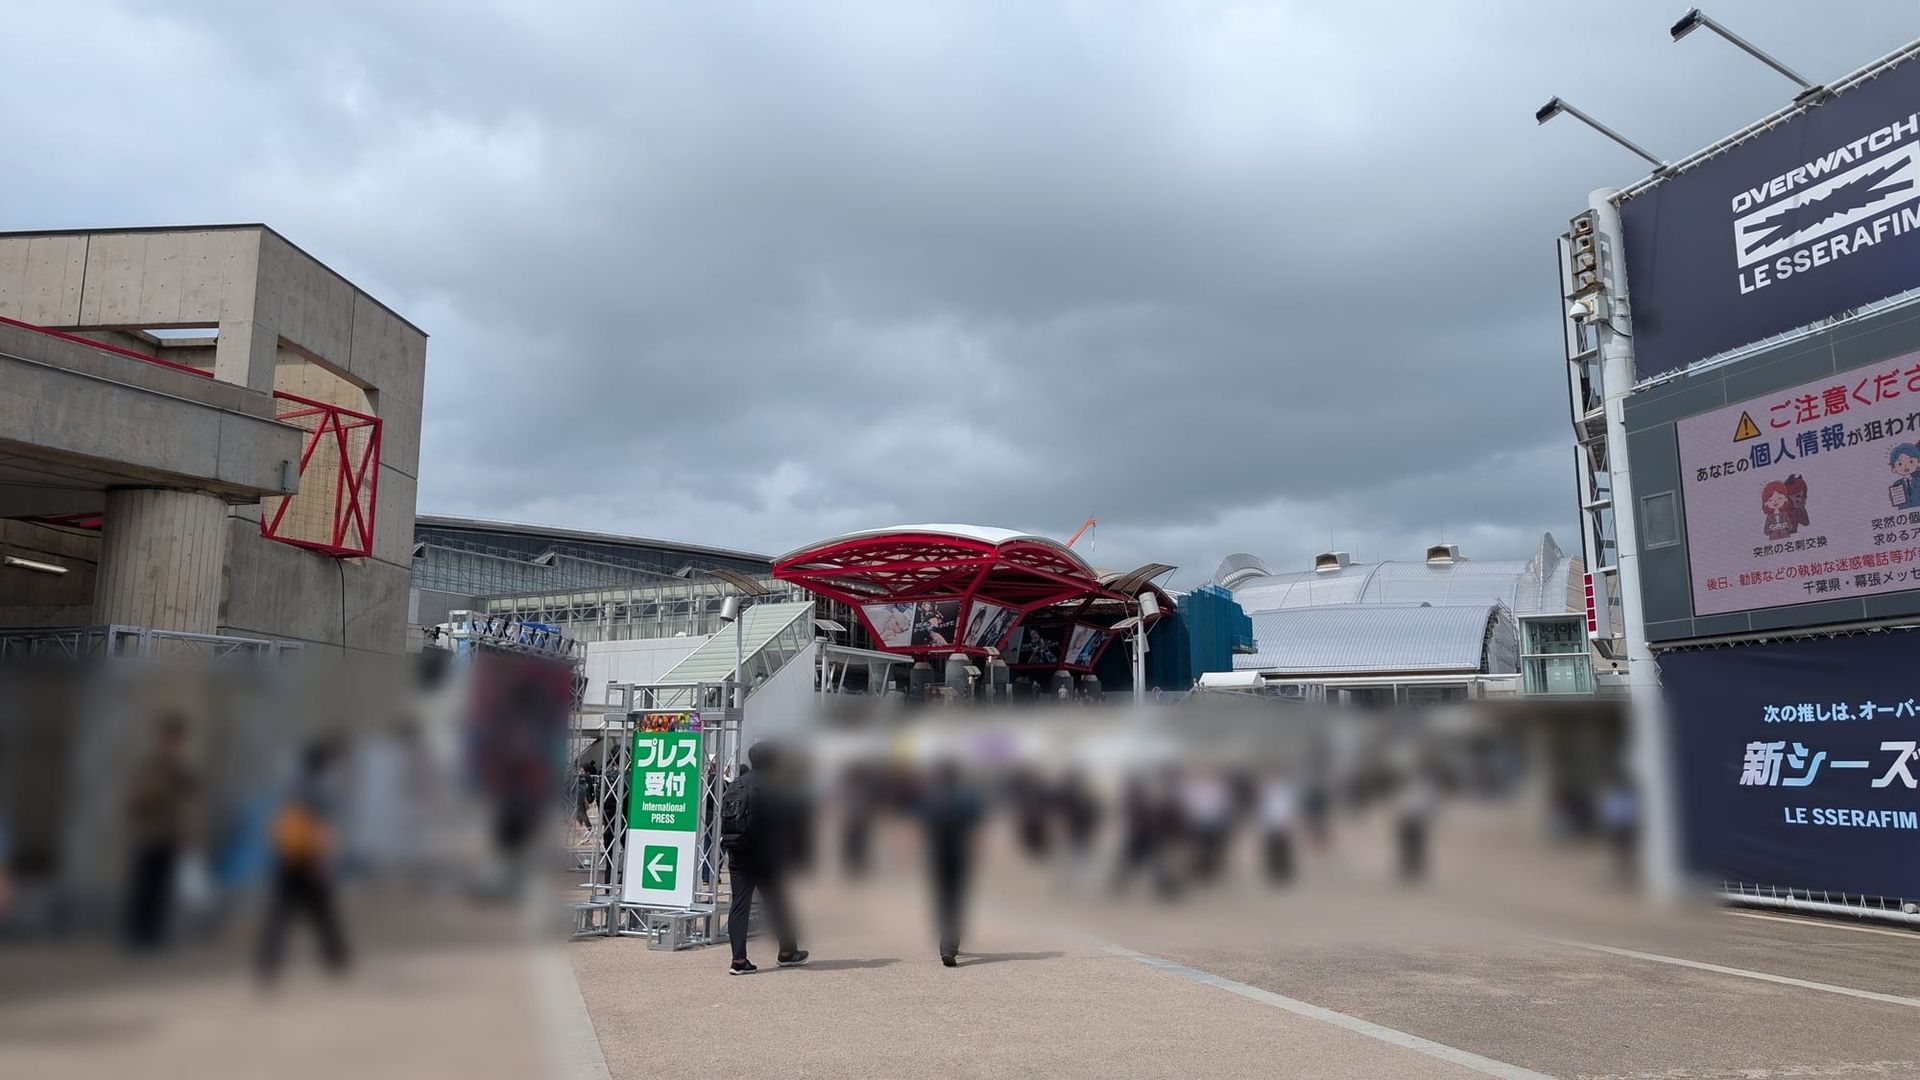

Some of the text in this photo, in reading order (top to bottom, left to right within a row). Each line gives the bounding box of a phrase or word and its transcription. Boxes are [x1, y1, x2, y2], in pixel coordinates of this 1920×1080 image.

[1732, 113, 1918, 213] OVERWATCH
[1739, 203, 1920, 294] LE SSERAFIM
[1753, 535, 1828, 558] 突然の名刺交換
[1705, 546, 1920, 591] 後日、勧誘などの執拗な迷惑電話等が
[638, 738, 697, 768] プレス
[1739, 741, 1920, 789] 新シーズ
[644, 772, 686, 797] 受付
[642, 801, 686, 813] International
[651, 813, 675, 824] PRESS
[1784, 807, 1918, 829] LE SSERAFIM
